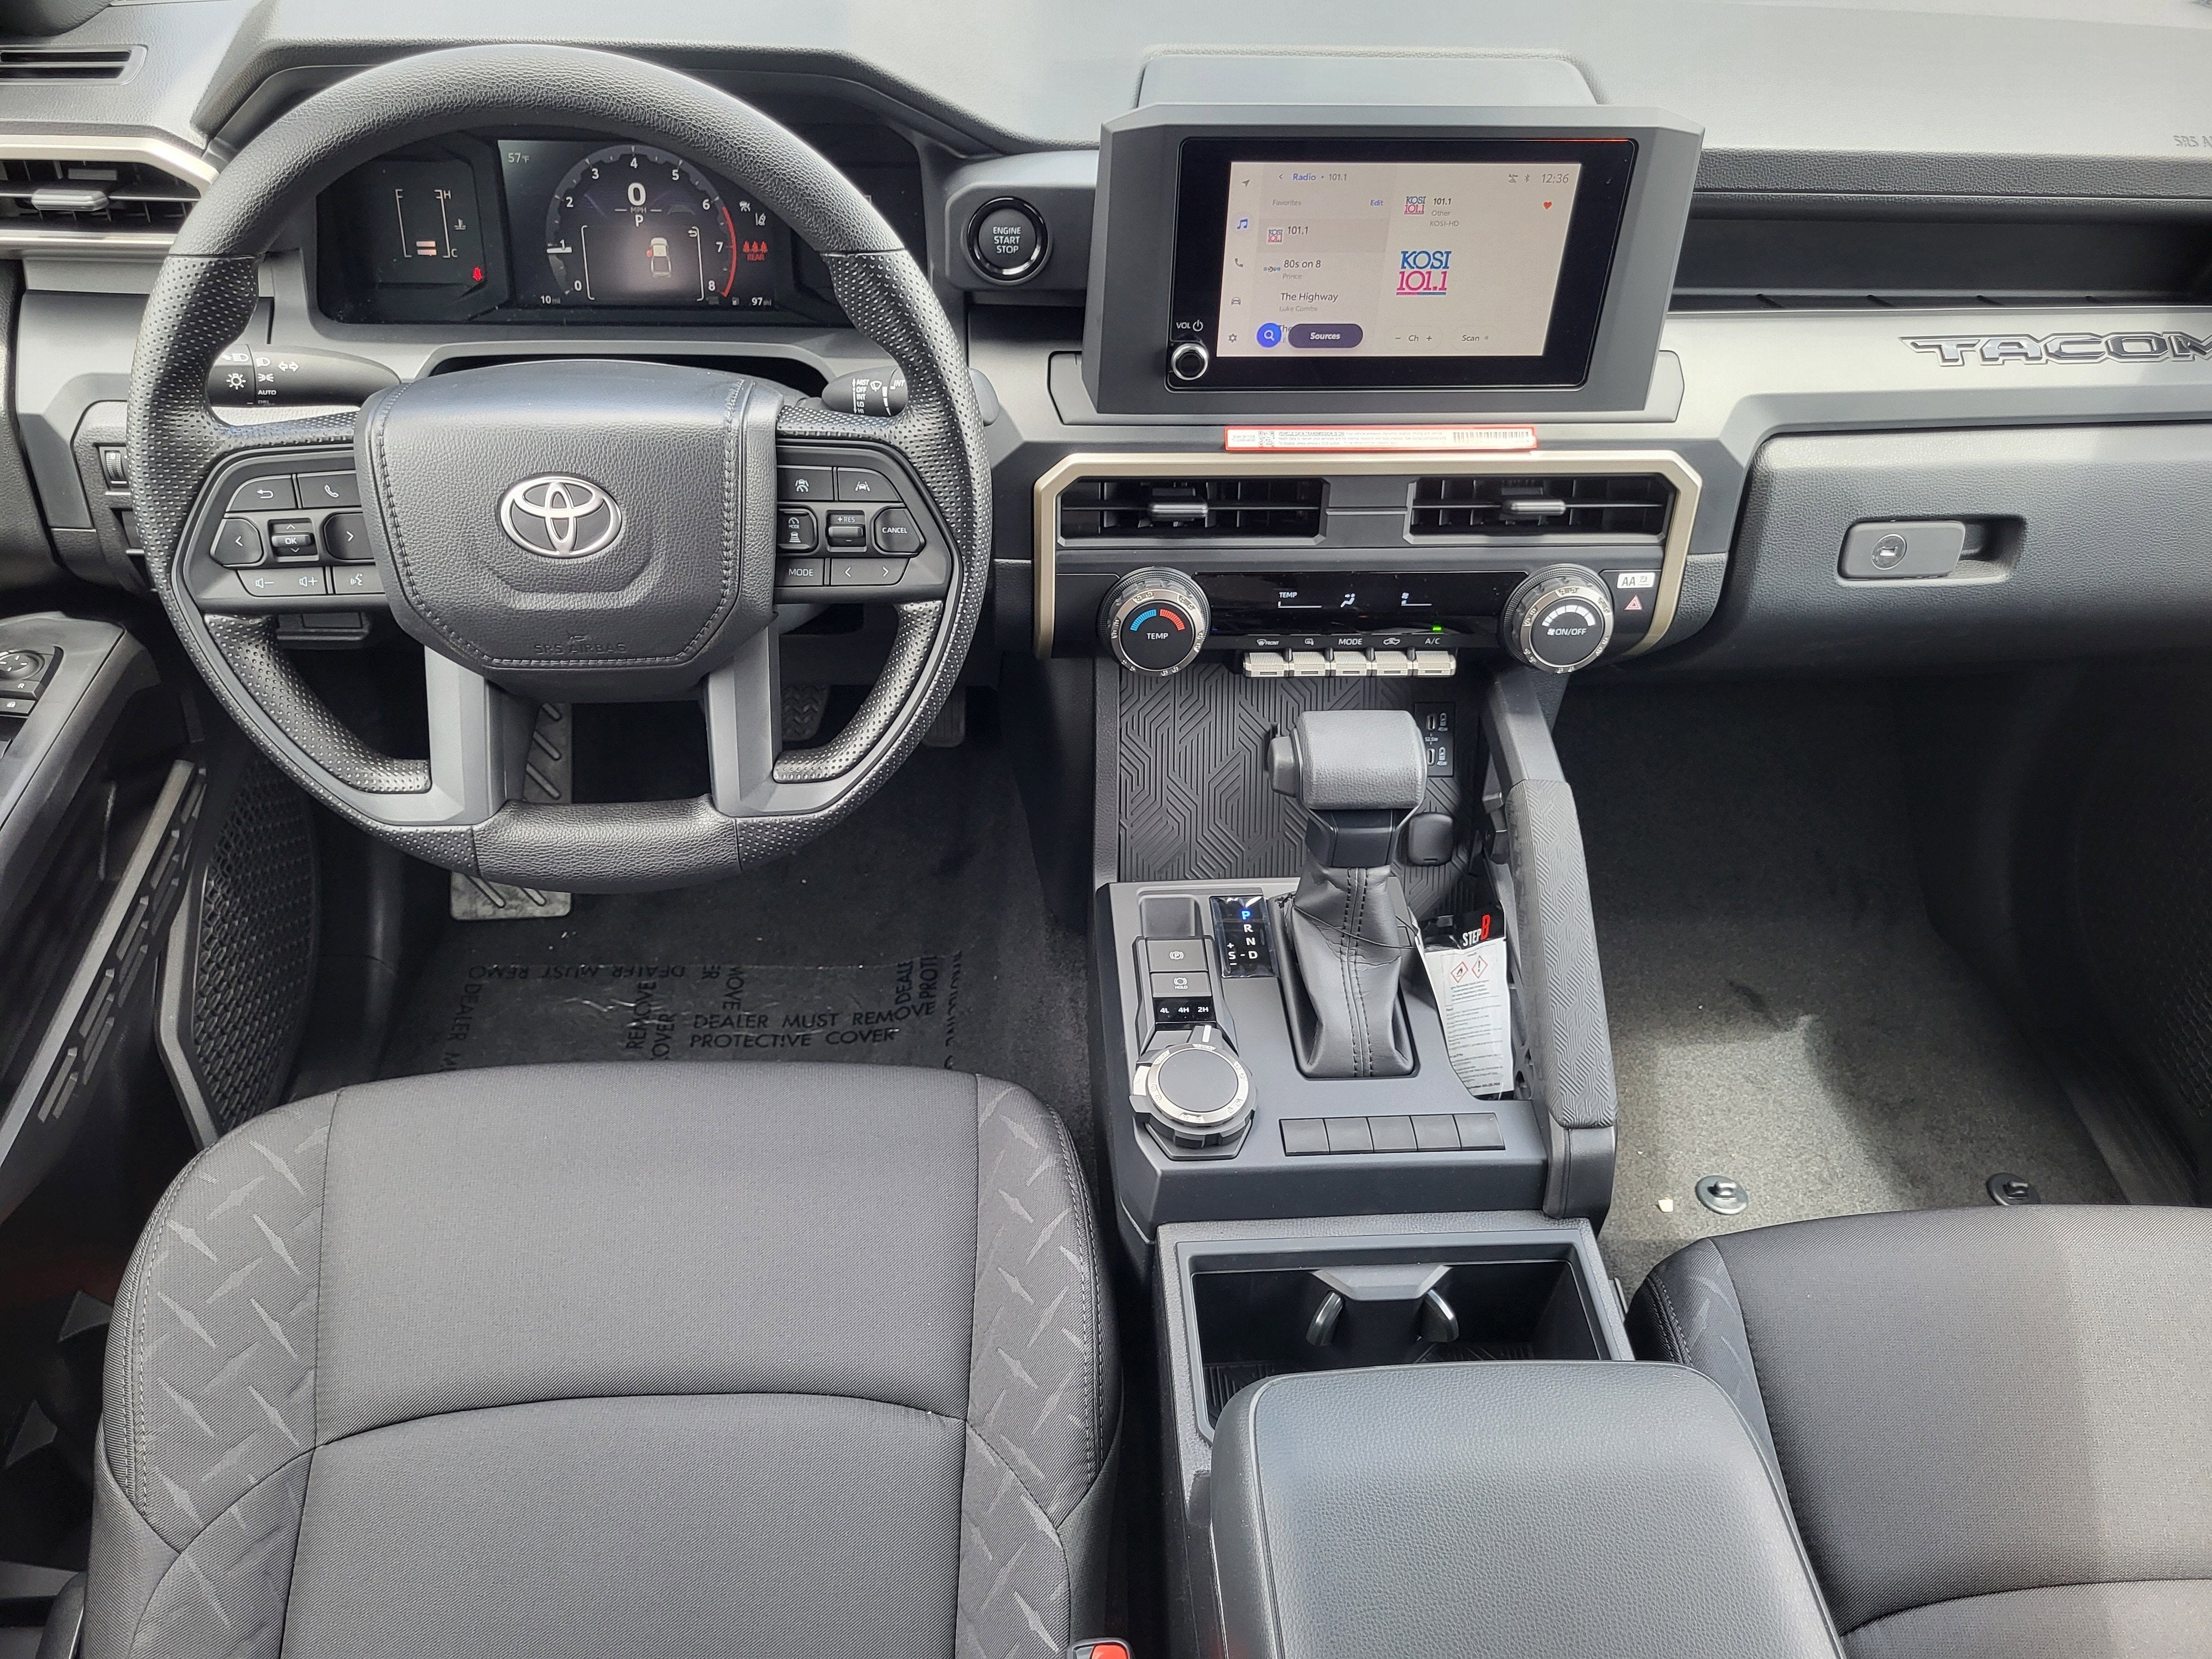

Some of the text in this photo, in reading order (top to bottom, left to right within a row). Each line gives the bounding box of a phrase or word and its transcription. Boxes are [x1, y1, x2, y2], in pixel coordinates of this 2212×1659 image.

[630, 158, 638, 169] 4
[592, 169, 599, 179] 3
[672, 170, 679, 180] 5
[1542, 174, 1569, 184] 12:36
[444, 191, 451, 199] H
[628, 182, 646, 206] 0
[566, 197, 573, 207] 2
[702, 199, 710, 210] 6
[1406, 196, 1426, 205] KOSI
[1404, 205, 1425, 213] 101.1
[635, 215, 644, 227] P
[1287, 226, 1308, 234] 101.1
[716, 242, 723, 252] 7
[452, 249, 458, 258] C
[1401, 251, 1452, 269] KOSI
[708, 280, 716, 291] 8
[1397, 270, 1447, 291] 101.1
[574, 281, 582, 291] 0
[540, 295, 551, 304] 10
[752, 297, 763, 306] 97
[1299, 293, 1338, 302] Highway
[1621, 577, 1635, 586] AA
[534, 643, 627, 655] SRS AIRBAG
[1241, 911, 1251, 920] P
[1244, 924, 1253, 932] R
[1246, 937, 1256, 946] N
[1462, 928, 1482, 947] STEP
[1248, 951, 1258, 959] D
[694, 1000, 936, 1029] DEALER MUST REMOVE
[650, 1013, 677, 1060] OVER
[690, 1030, 897, 1048] PROTECTIVE COVER
